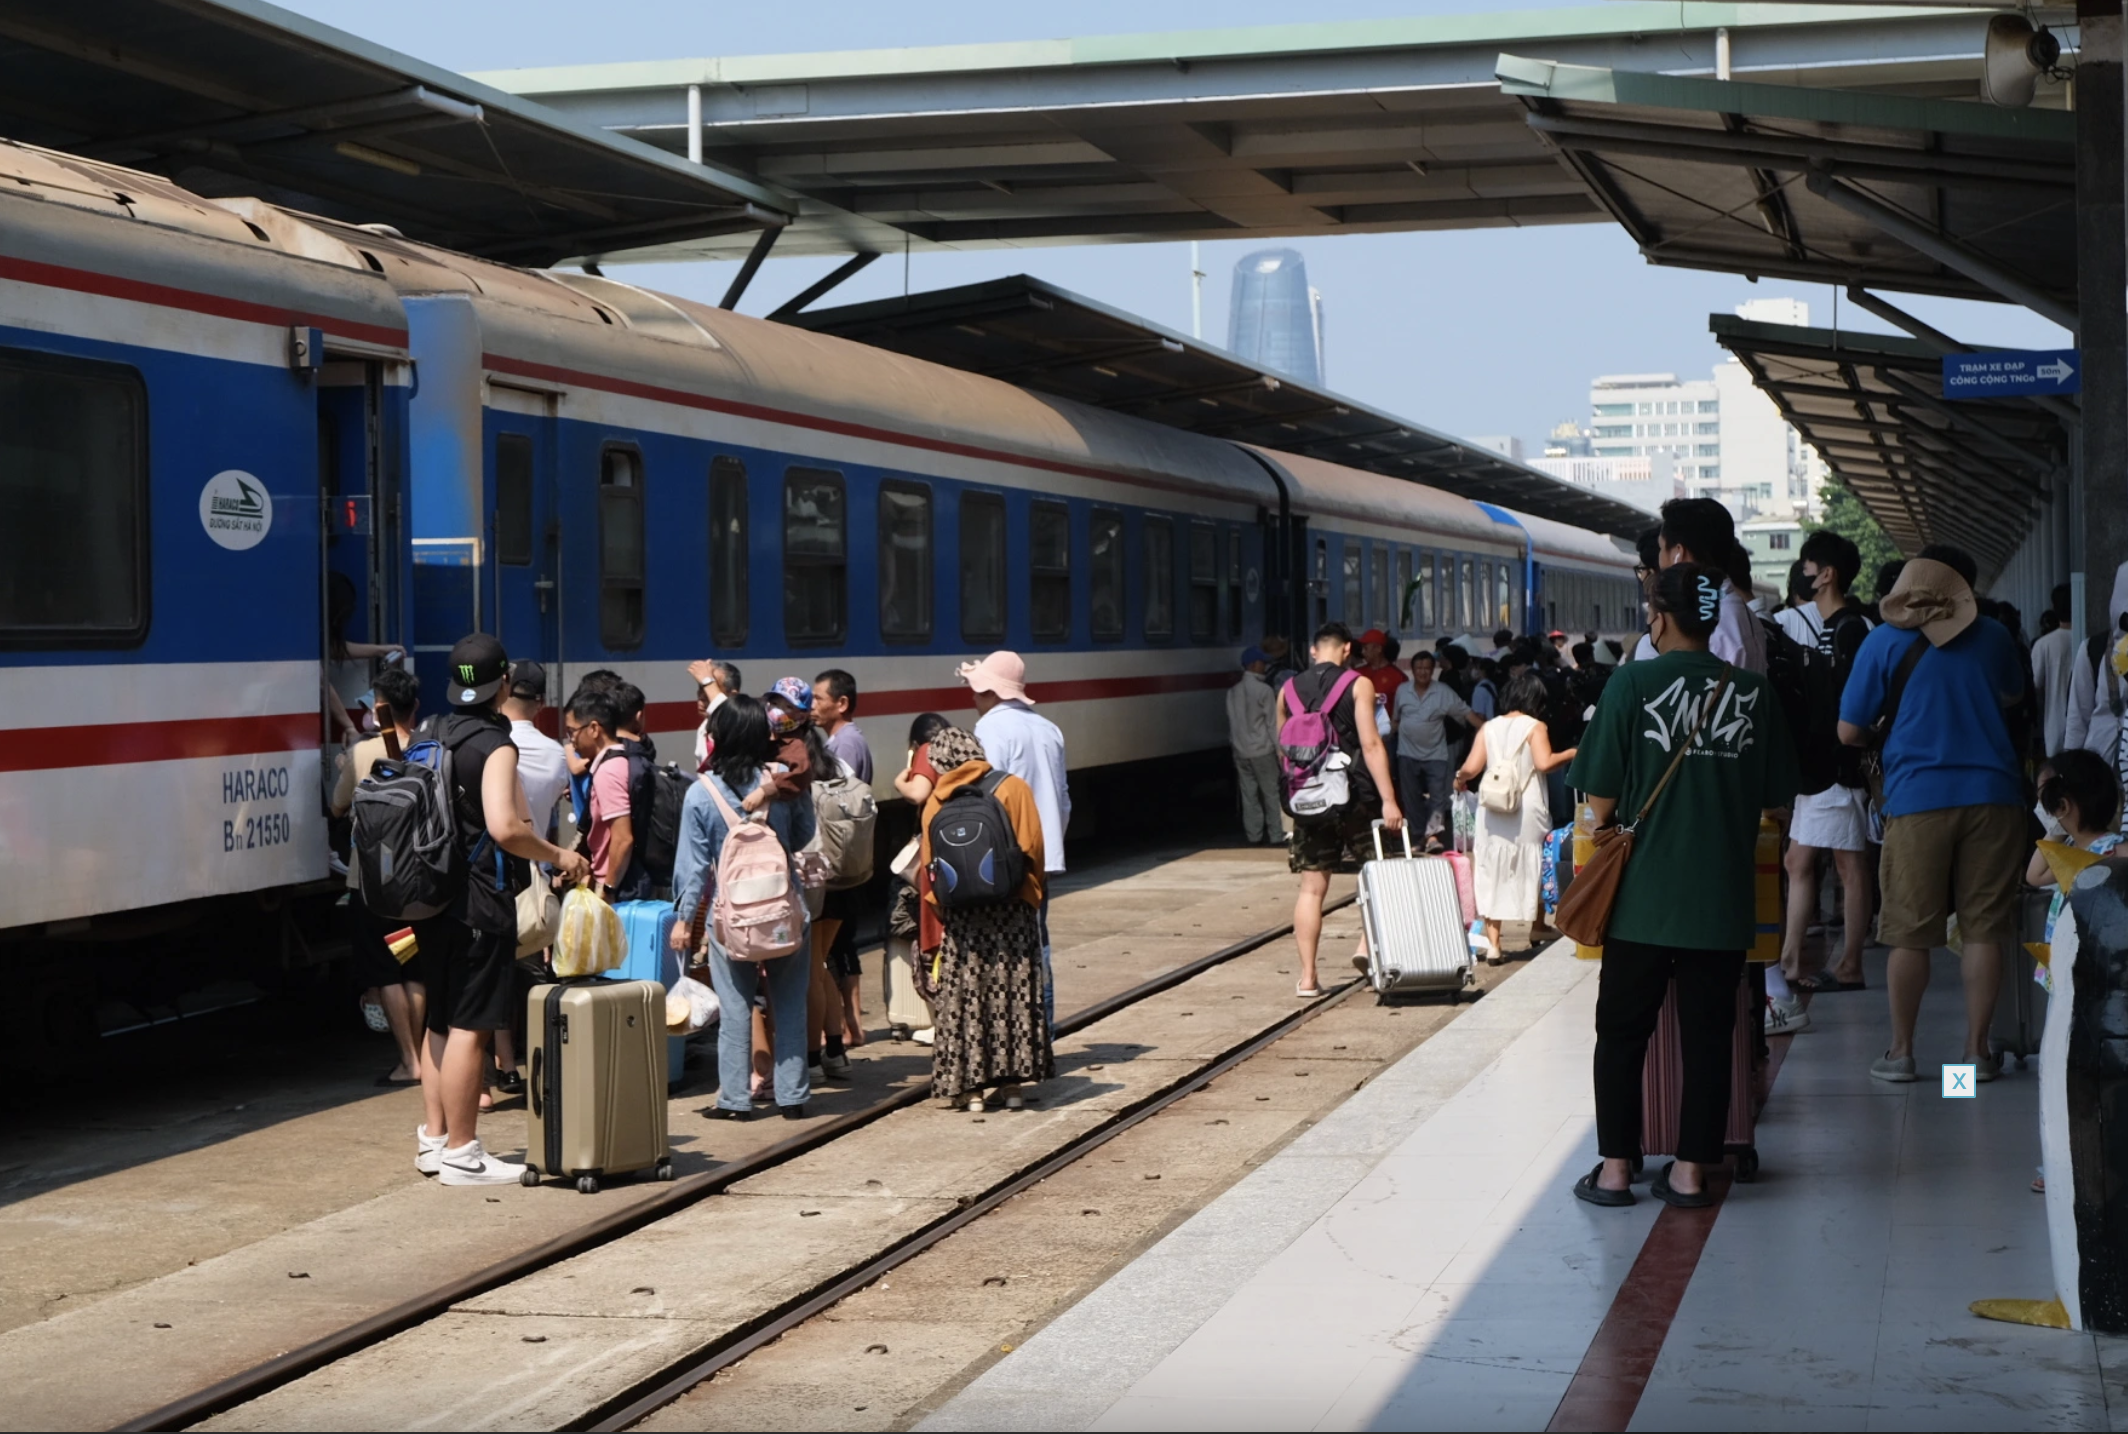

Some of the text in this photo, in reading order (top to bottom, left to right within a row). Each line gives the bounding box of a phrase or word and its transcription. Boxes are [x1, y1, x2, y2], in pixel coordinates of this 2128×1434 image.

[1959, 362, 2025, 374] TRẠM XE ĐẠP
[2041, 366, 2061, 376] 50m
[1949, 375, 1978, 385] CÔNG
[1980, 374, 2008, 385] CỘNG
[222, 767, 289, 804] HARACO
[246, 813, 290, 850] 21550
